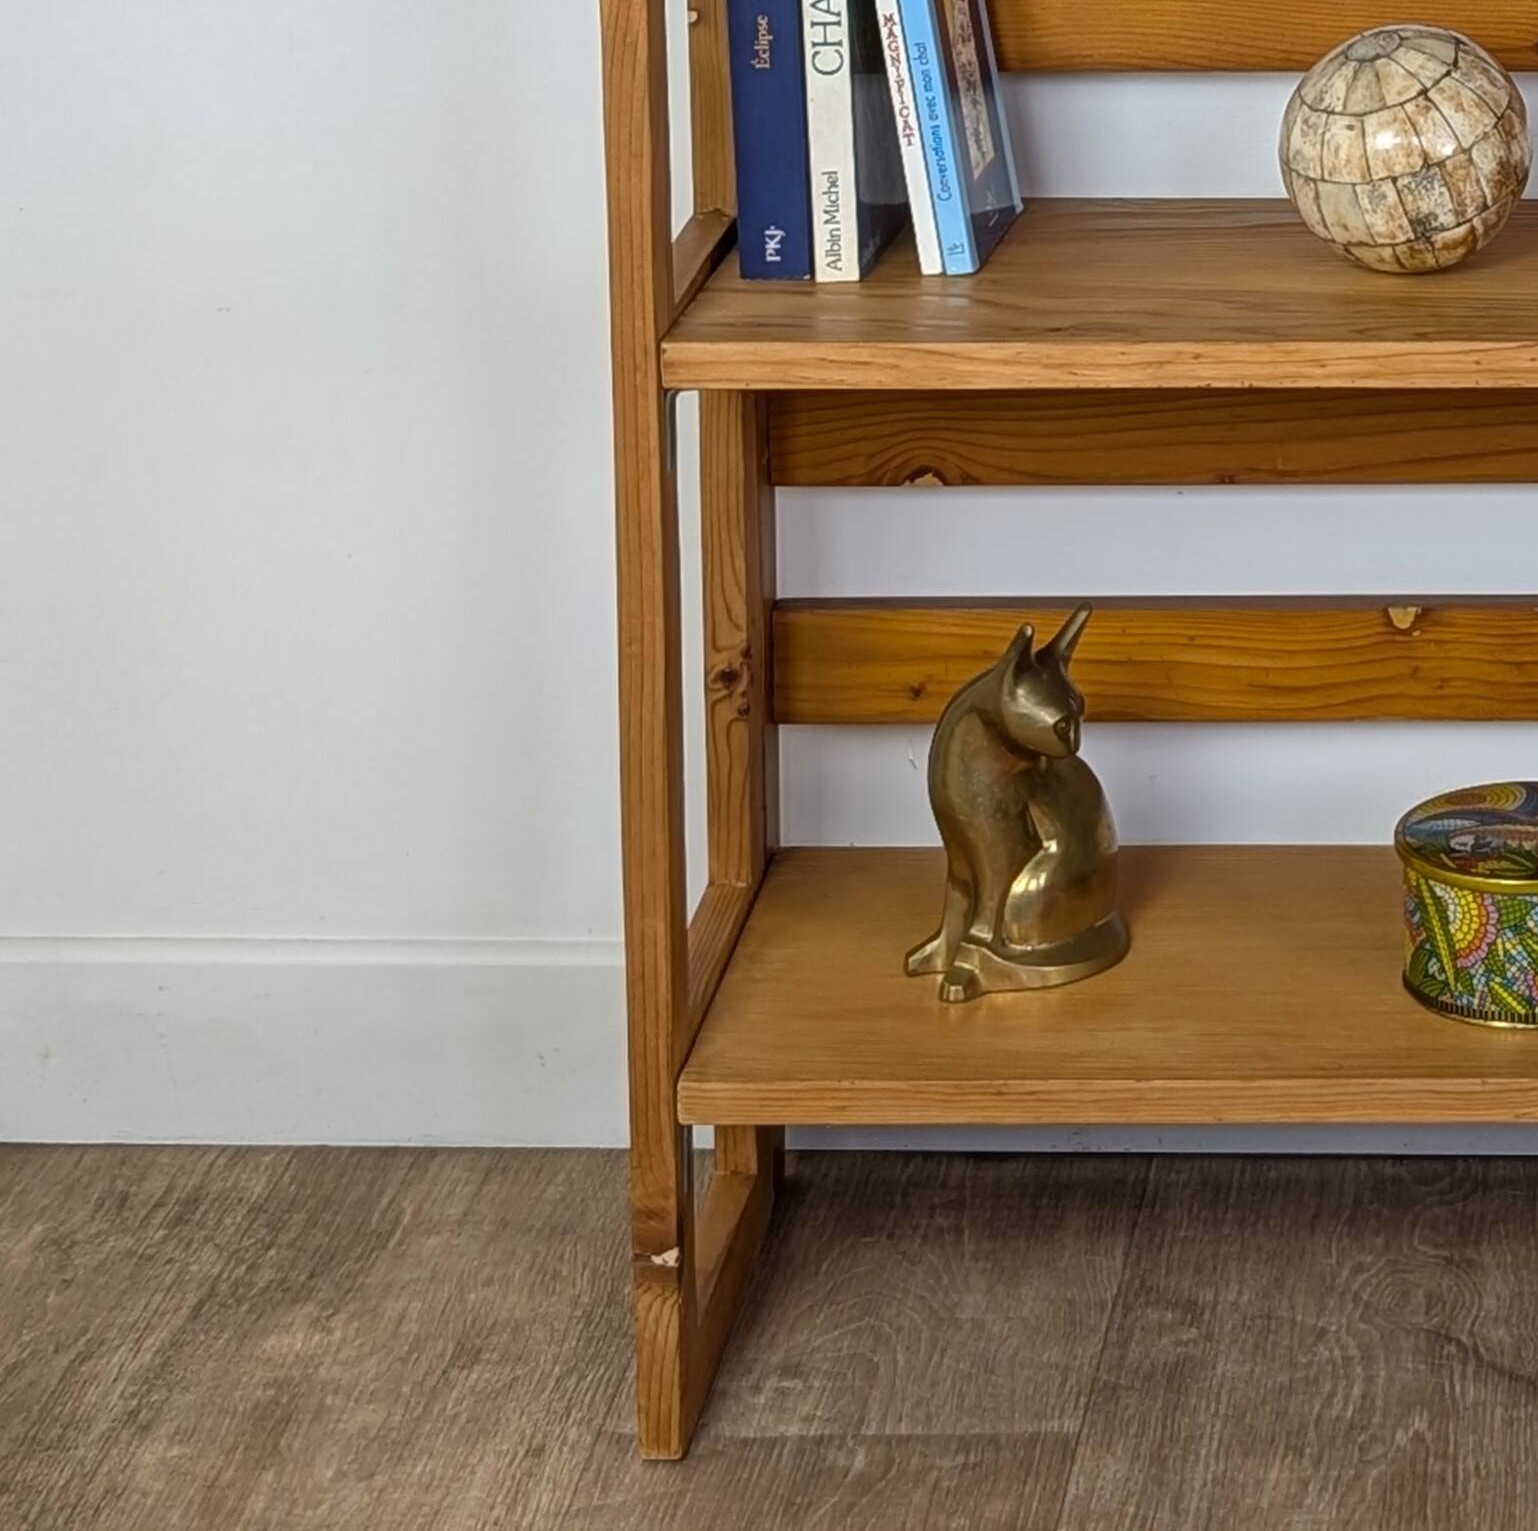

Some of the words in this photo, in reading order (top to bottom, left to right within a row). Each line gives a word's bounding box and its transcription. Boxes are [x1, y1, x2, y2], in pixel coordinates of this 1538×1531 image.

[751, 14, 774, 69] Éclipse
[912, 41, 929, 67] chat
[922, 69, 938, 95] mon
[927, 98, 941, 122] avec
[929, 123, 953, 202] Conversations
[821, 170, 840, 227] Michel
[825, 227, 843, 272] Albin
